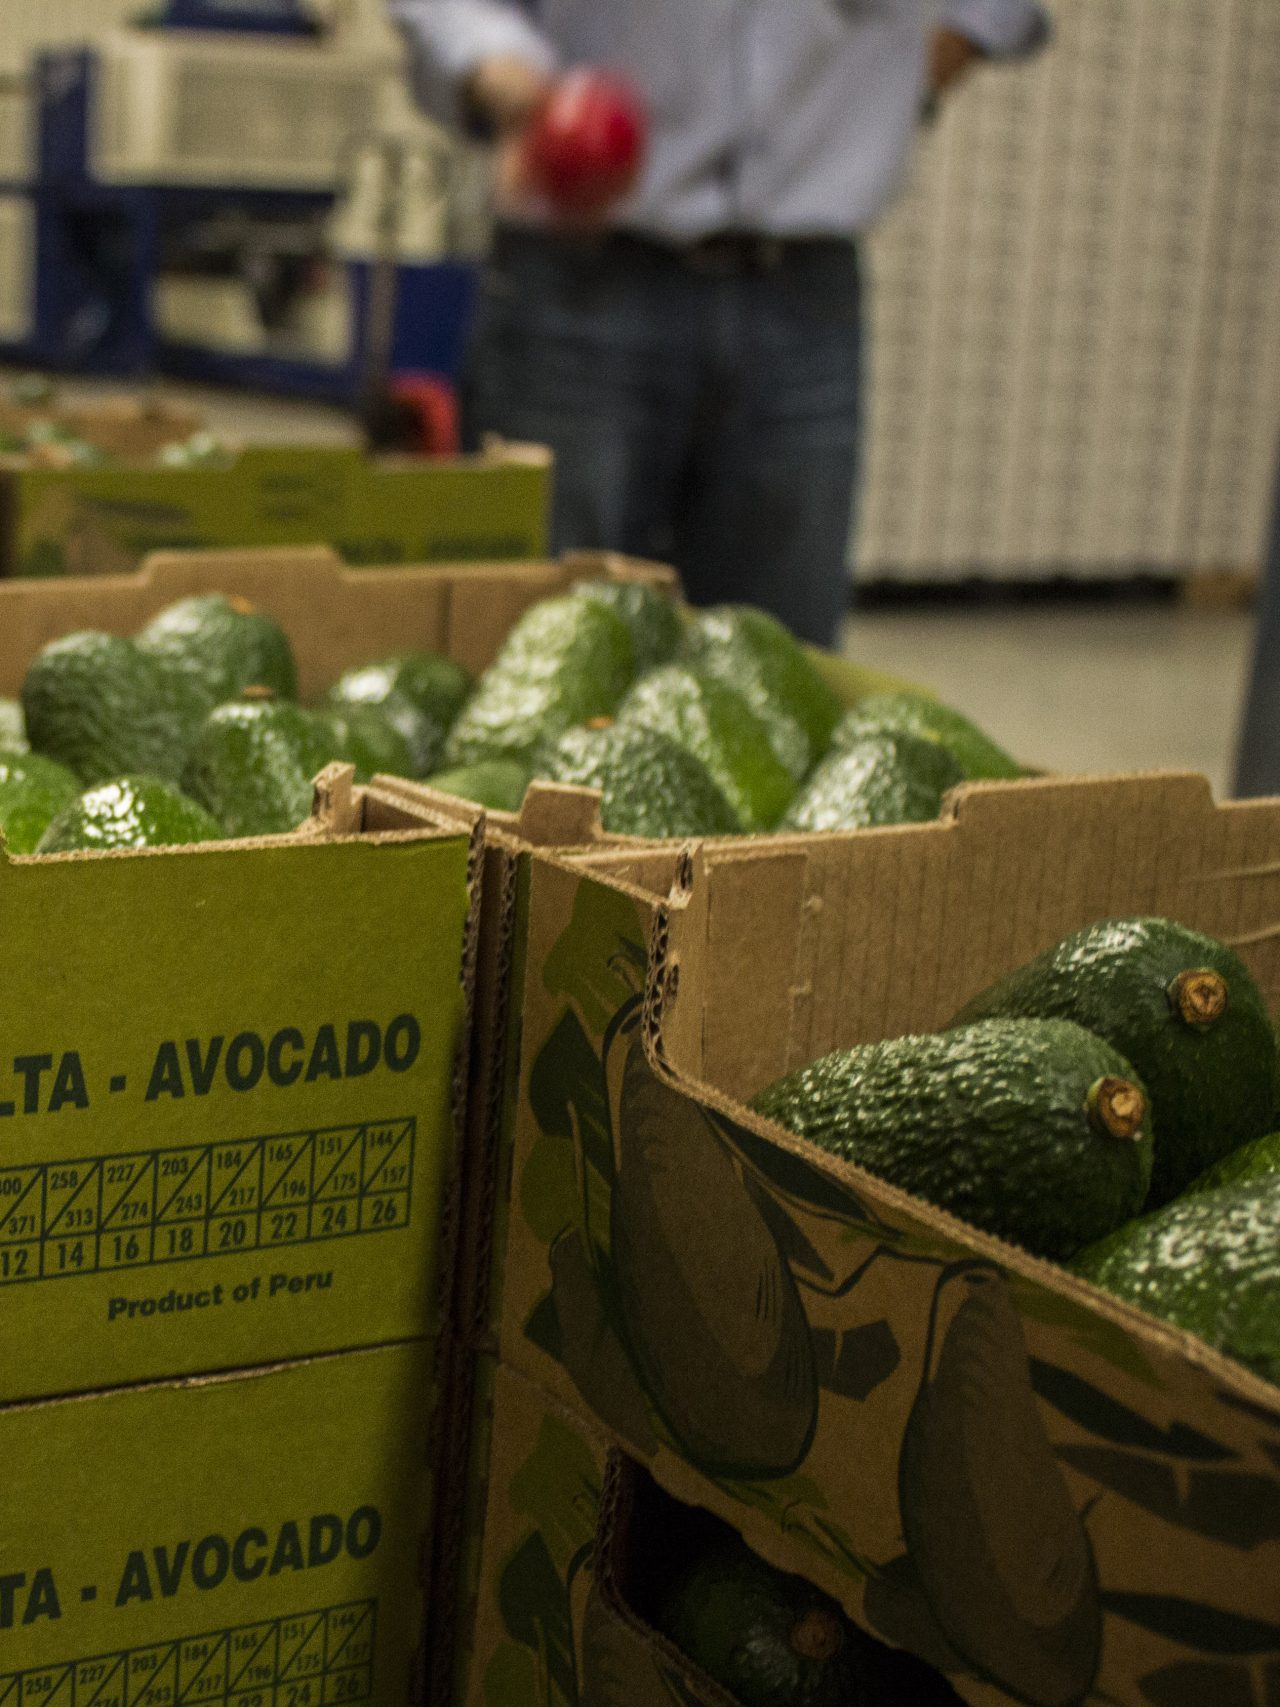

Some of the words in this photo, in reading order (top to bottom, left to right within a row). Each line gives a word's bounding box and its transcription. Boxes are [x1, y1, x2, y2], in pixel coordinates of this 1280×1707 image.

[145, 1014, 421, 1101] AVOCADO
[50, 1171, 79, 1190] 258
[107, 1164, 135, 1183] 227
[161, 1158, 189, 1177] 203
[217, 1150, 241, 1169] 184
[269, 1144, 293, 1162] 165
[321, 1136, 343, 1155] 151
[371, 1130, 394, 1147] 144
[8, 1215, 36, 1235] 371
[64, 1208, 94, 1228] 313
[122, 1201, 147, 1221] 274
[175, 1193, 202, 1213] 243
[230, 1186, 255, 1206] 217
[282, 1180, 307, 1198] 196
[333, 1172, 357, 1191] 175
[383, 1165, 407, 1183] 157
[1, 1249, 28, 1277] 12
[58, 1243, 83, 1269] 14
[113, 1235, 139, 1262] 16
[168, 1227, 193, 1254] 18
[219, 1220, 246, 1248] 20
[272, 1212, 297, 1239] 22
[323, 1205, 347, 1232] 24
[372, 1198, 397, 1224] 26
[108, 1283, 223, 1321] Product
[233, 1276, 260, 1303] of
[270, 1270, 333, 1297] Peru
[115, 1505, 382, 1607] AVOCADO
[26, 1677, 53, 1696] 258
[80, 1665, 106, 1685] 227
[132, 1655, 157, 1674] 203
[288, 1683, 311, 1707] 24
[336, 1673, 360, 1697] 26
